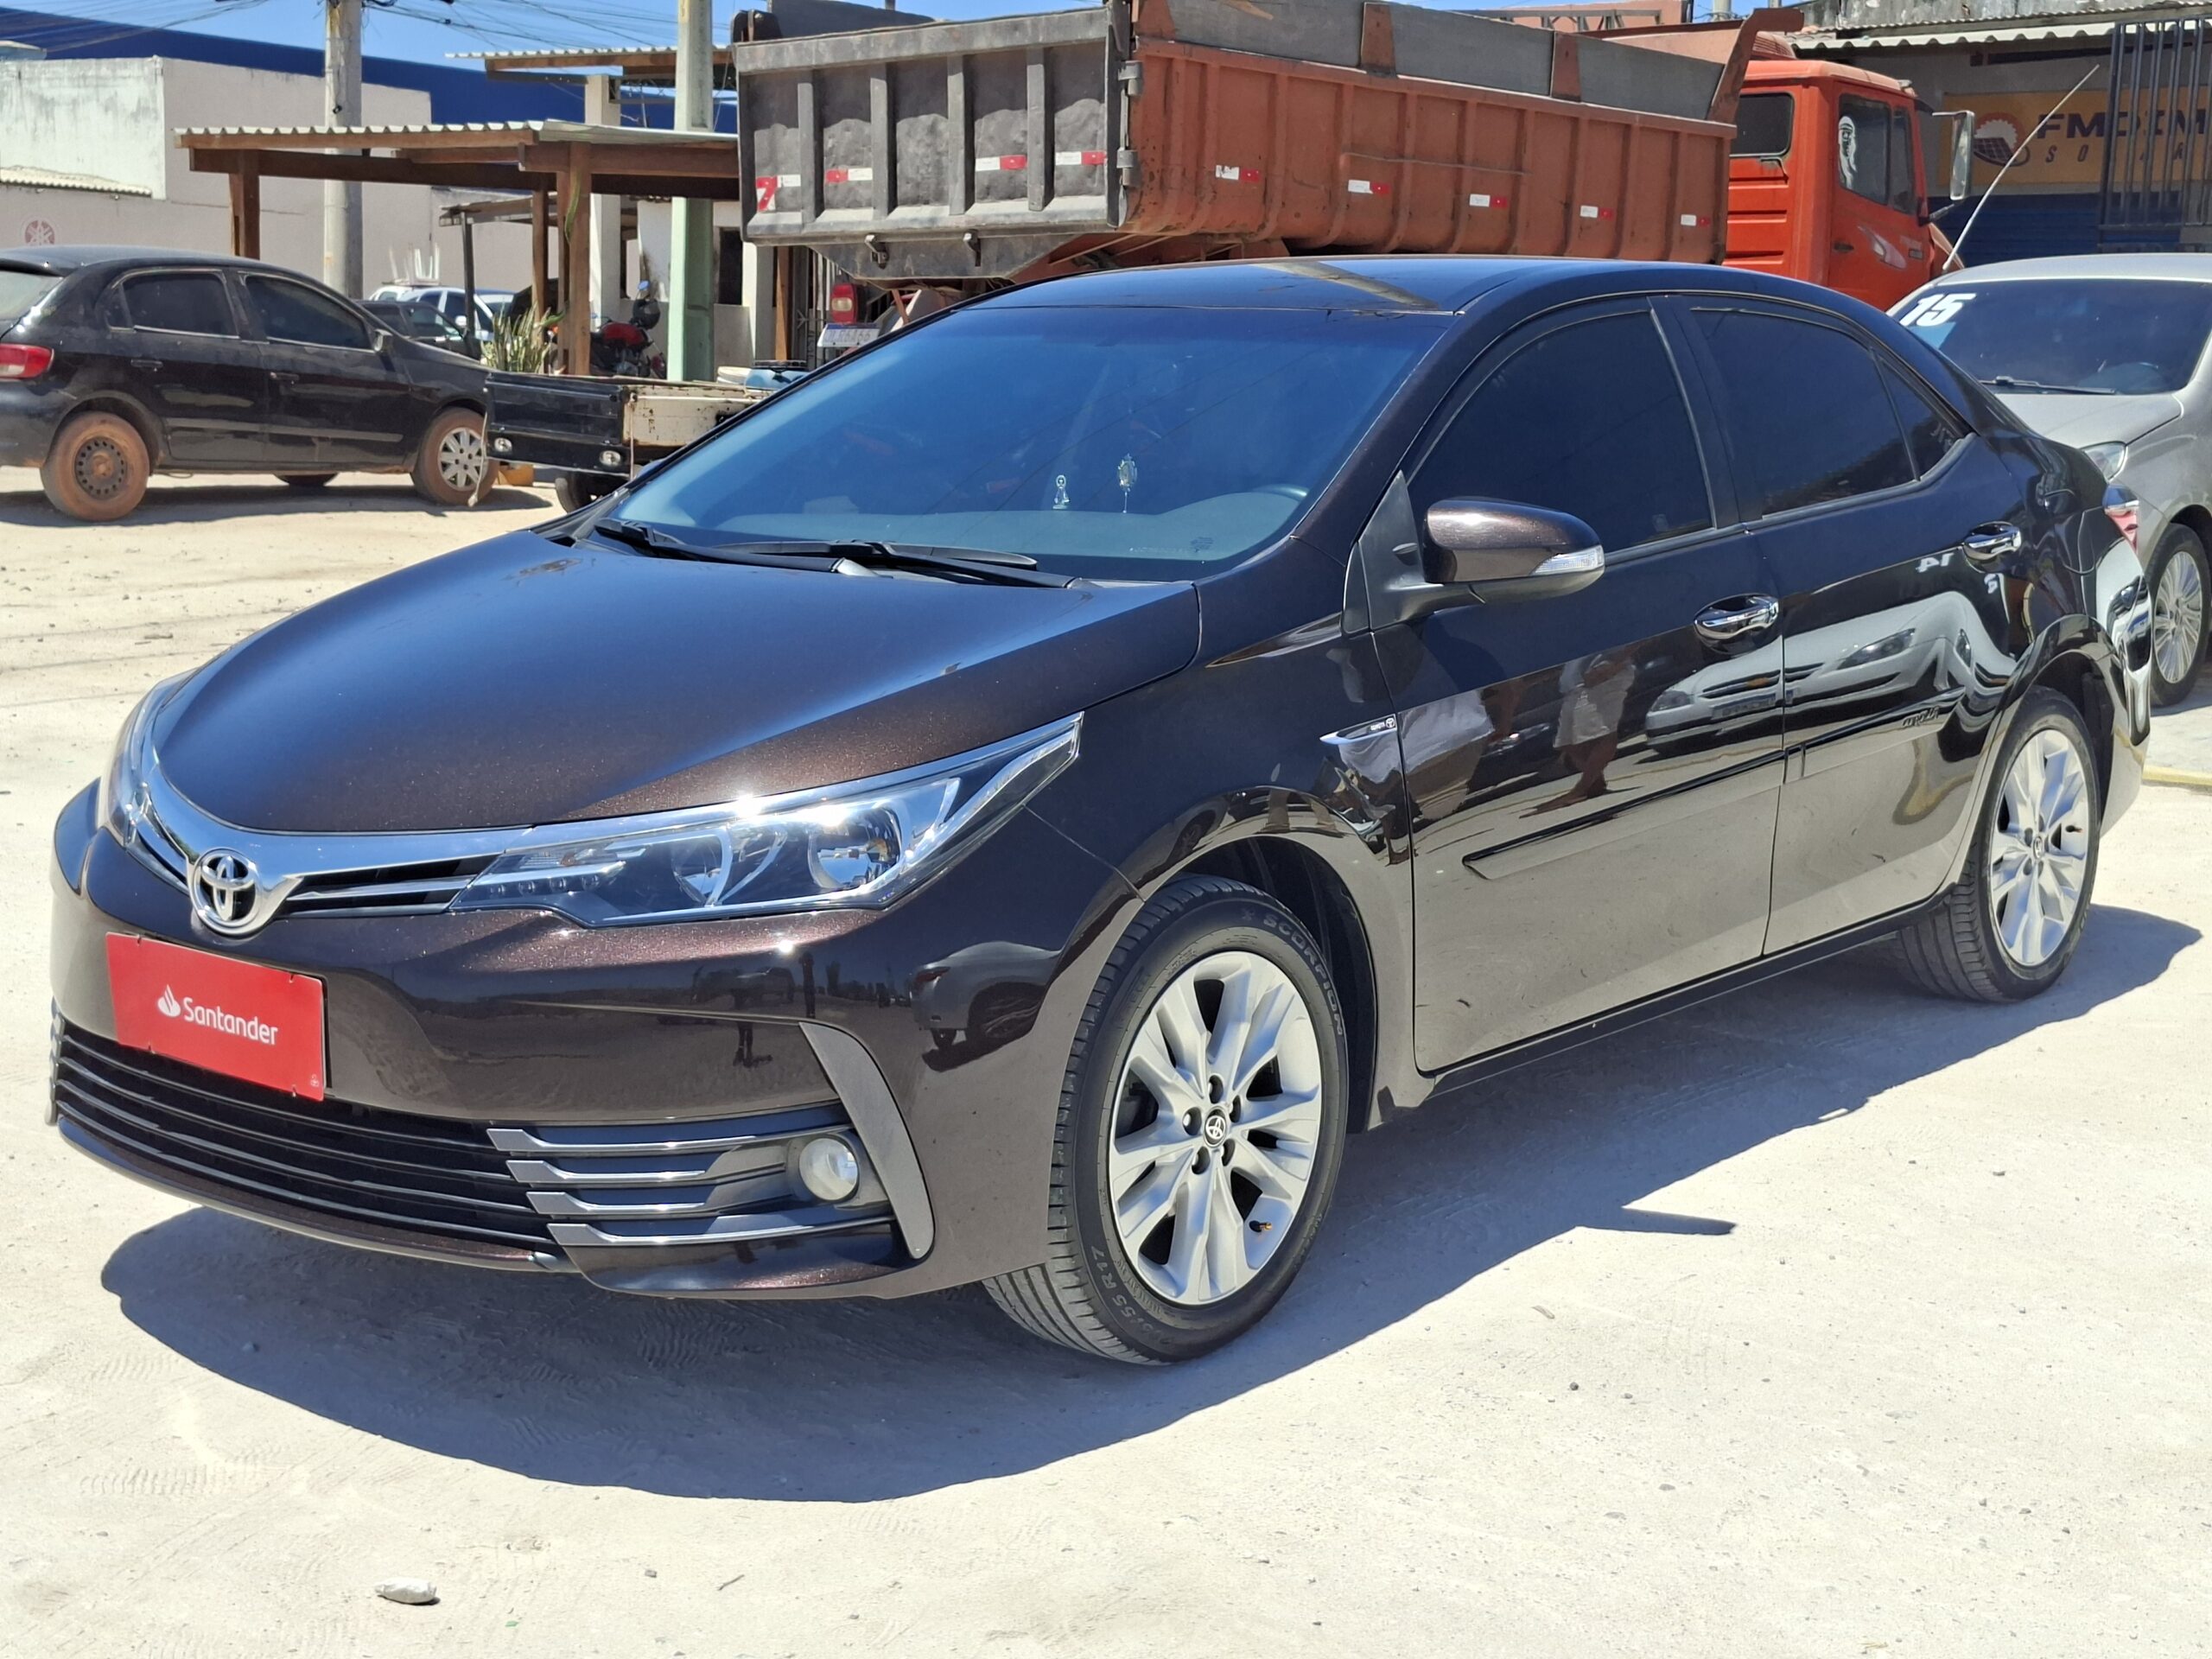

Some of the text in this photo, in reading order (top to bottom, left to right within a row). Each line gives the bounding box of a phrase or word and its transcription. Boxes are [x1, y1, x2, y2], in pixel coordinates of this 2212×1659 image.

[1899, 293, 1977, 327] 15
[1262, 912, 1344, 1035] SCORPION
[182, 996, 278, 1046] Santander
